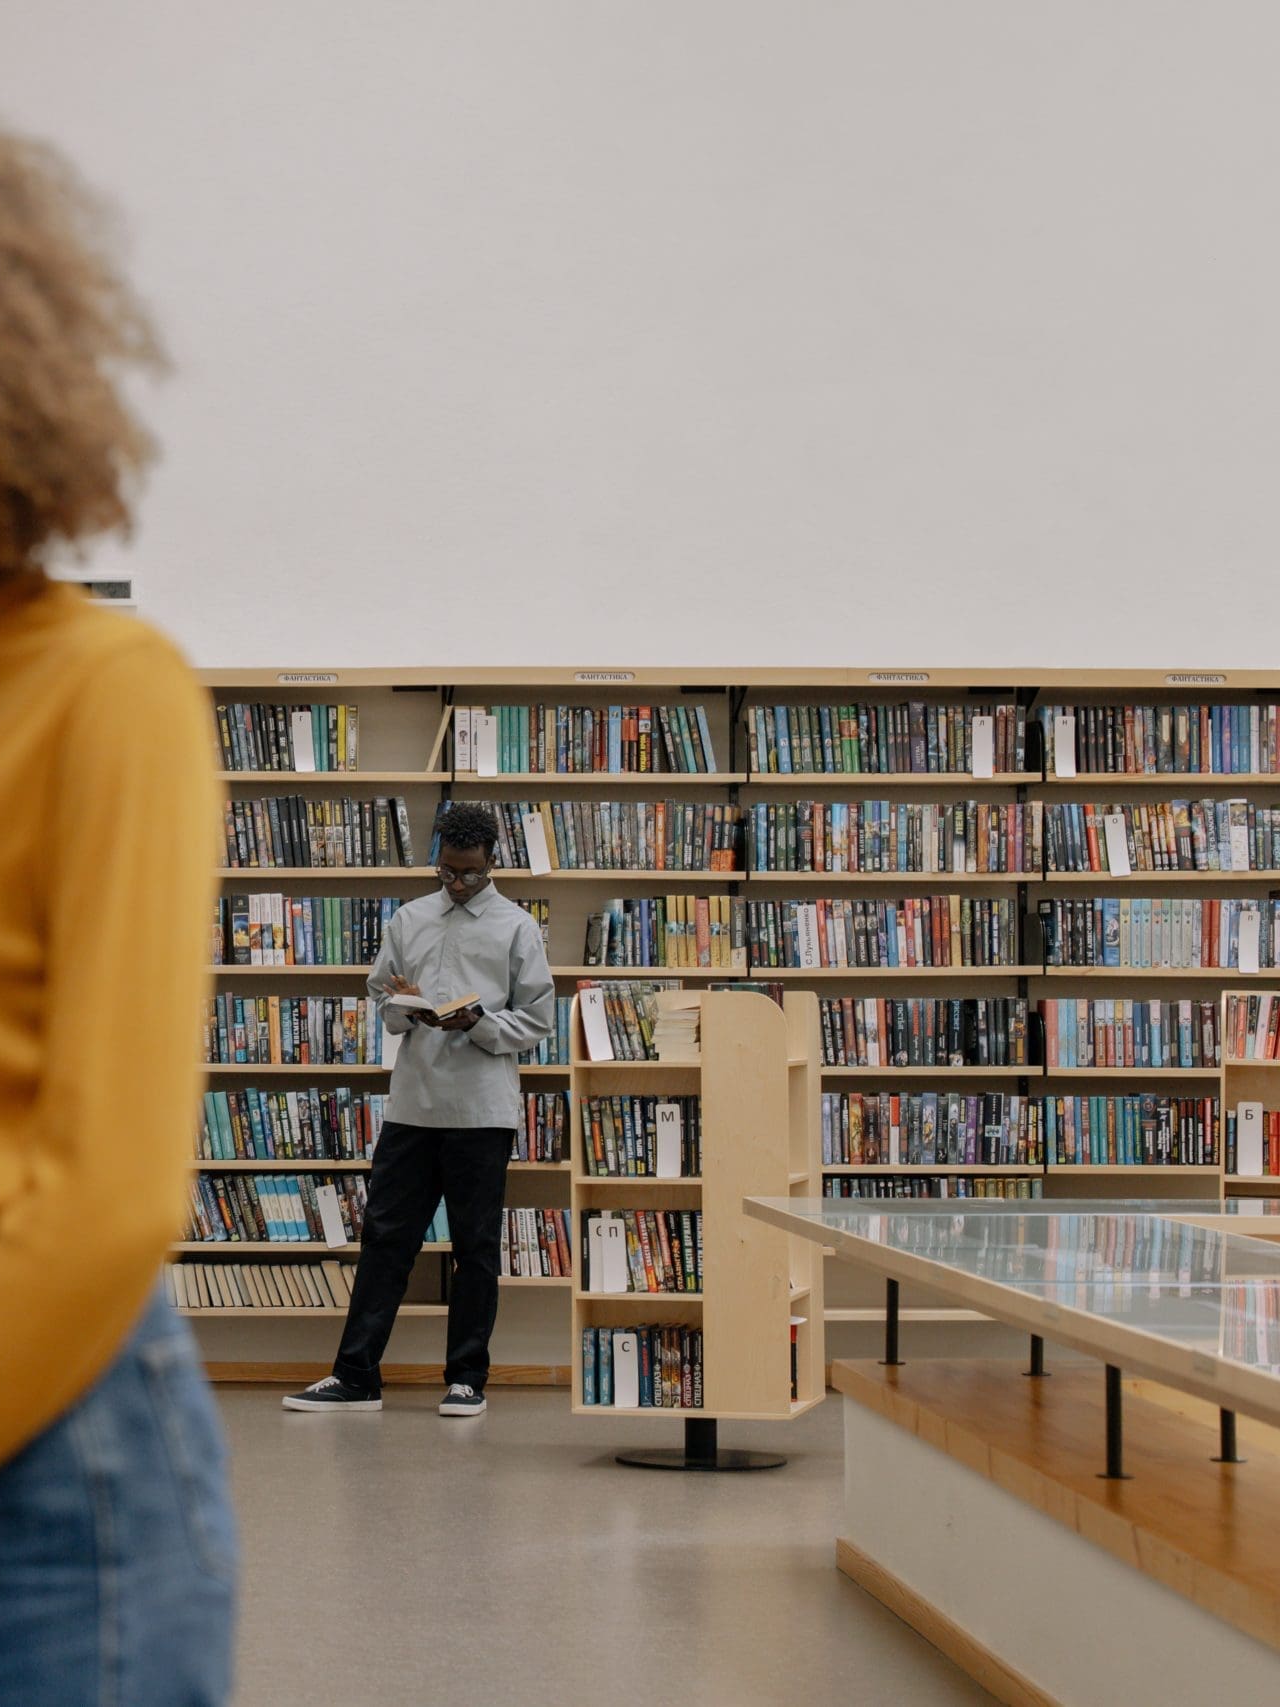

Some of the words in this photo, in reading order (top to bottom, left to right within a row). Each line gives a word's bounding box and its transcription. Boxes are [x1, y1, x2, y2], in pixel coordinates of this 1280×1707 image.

[955, 811, 963, 835] ЛЕМ
[590, 994, 597, 1004] К
[662, 1111, 674, 1122] М
[1245, 1110, 1254, 1121] Б
[609, 1227, 618, 1237] П
[622, 1341, 630, 1352] С
[654, 1372, 662, 1406] СПЕЦНАЗ
